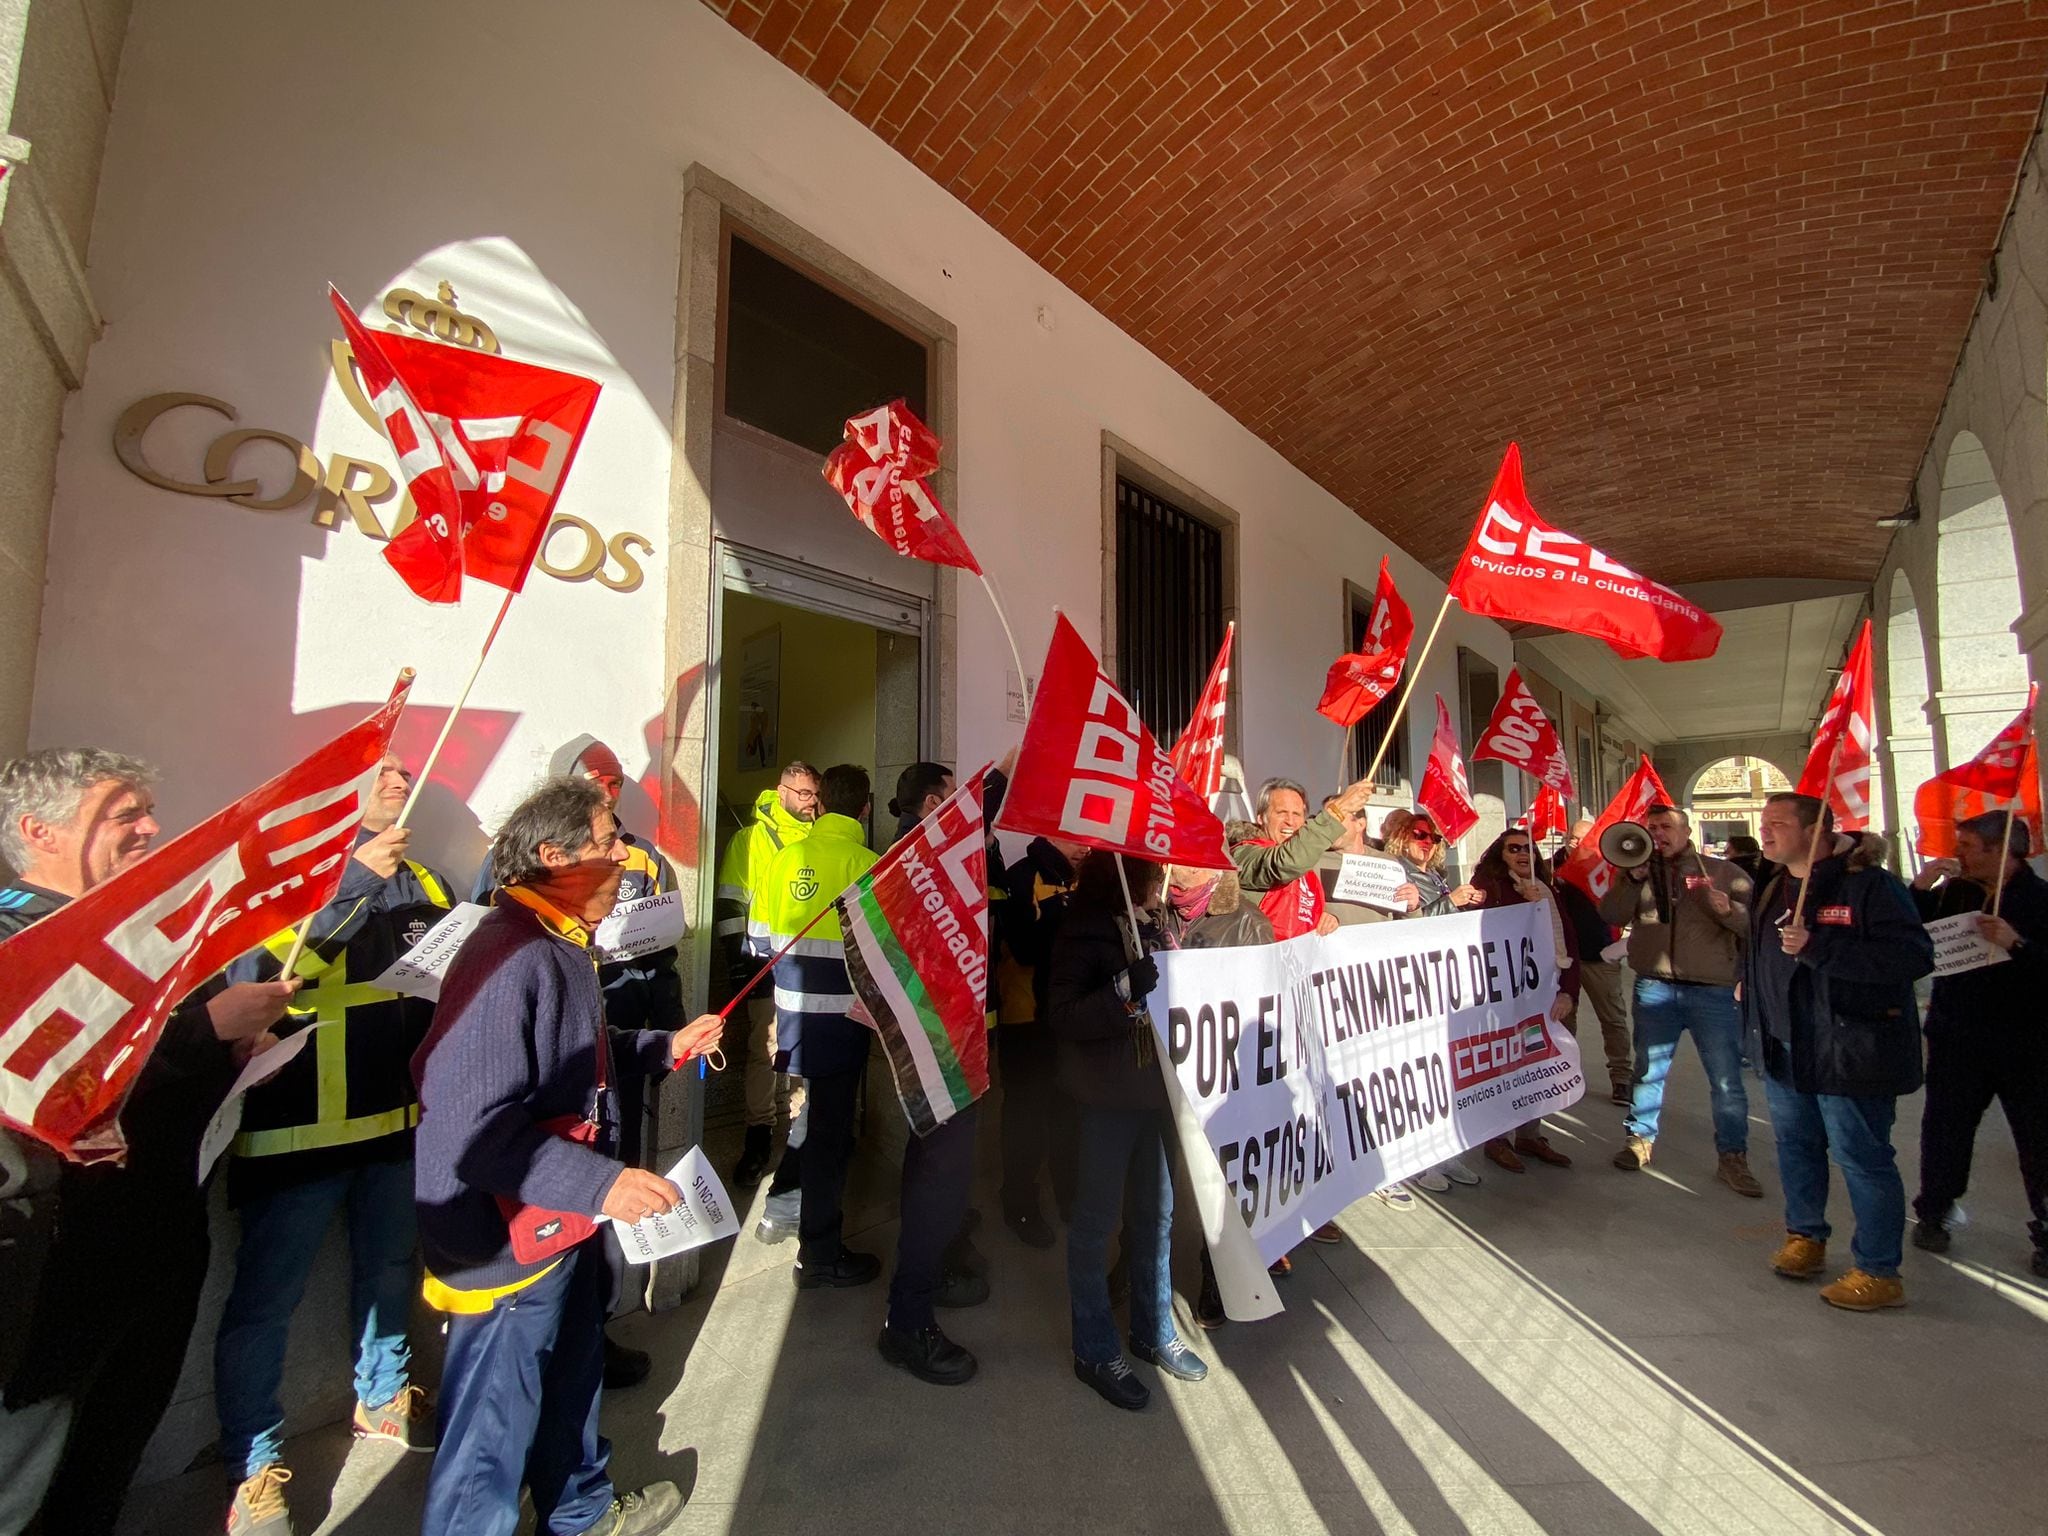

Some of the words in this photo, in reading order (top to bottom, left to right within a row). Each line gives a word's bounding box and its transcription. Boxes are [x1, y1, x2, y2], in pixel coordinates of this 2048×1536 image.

[113, 392, 654, 592] COROS
[1471, 555, 1546, 578] ervicios
[1552, 570, 1565, 581] a
[1571, 570, 1588, 585] la
[1595, 579, 1700, 623] ciudadanía
[1702, 811, 1744, 820] OPTICA
[1357, 860, 1387, 870] CARTERO
[625, 895, 674, 915] LABORAL
[1343, 888, 1368, 897] MENOS
[1940, 921, 1959, 931] HAY
[395, 968, 409, 977] SI
[406, 955, 424, 969] NO
[422, 920, 462, 955] CUBREN
[1168, 1000, 1240, 1098] POR
[1256, 993, 1288, 1086] EL
[1466, 941, 1503, 1007] DE
[1454, 1033, 1522, 1080] CCOO
[1457, 1085, 1496, 1110] servicios
[1496, 1084, 1503, 1095] a
[1503, 1079, 1511, 1092] la
[1511, 1073, 1582, 1111] extremadura
[1218, 1112, 1307, 1229] ESTOS
[1336, 1052, 1449, 1162] TRABAJO
[692, 1175, 703, 1190] SI
[700, 1186, 713, 1203] NO
